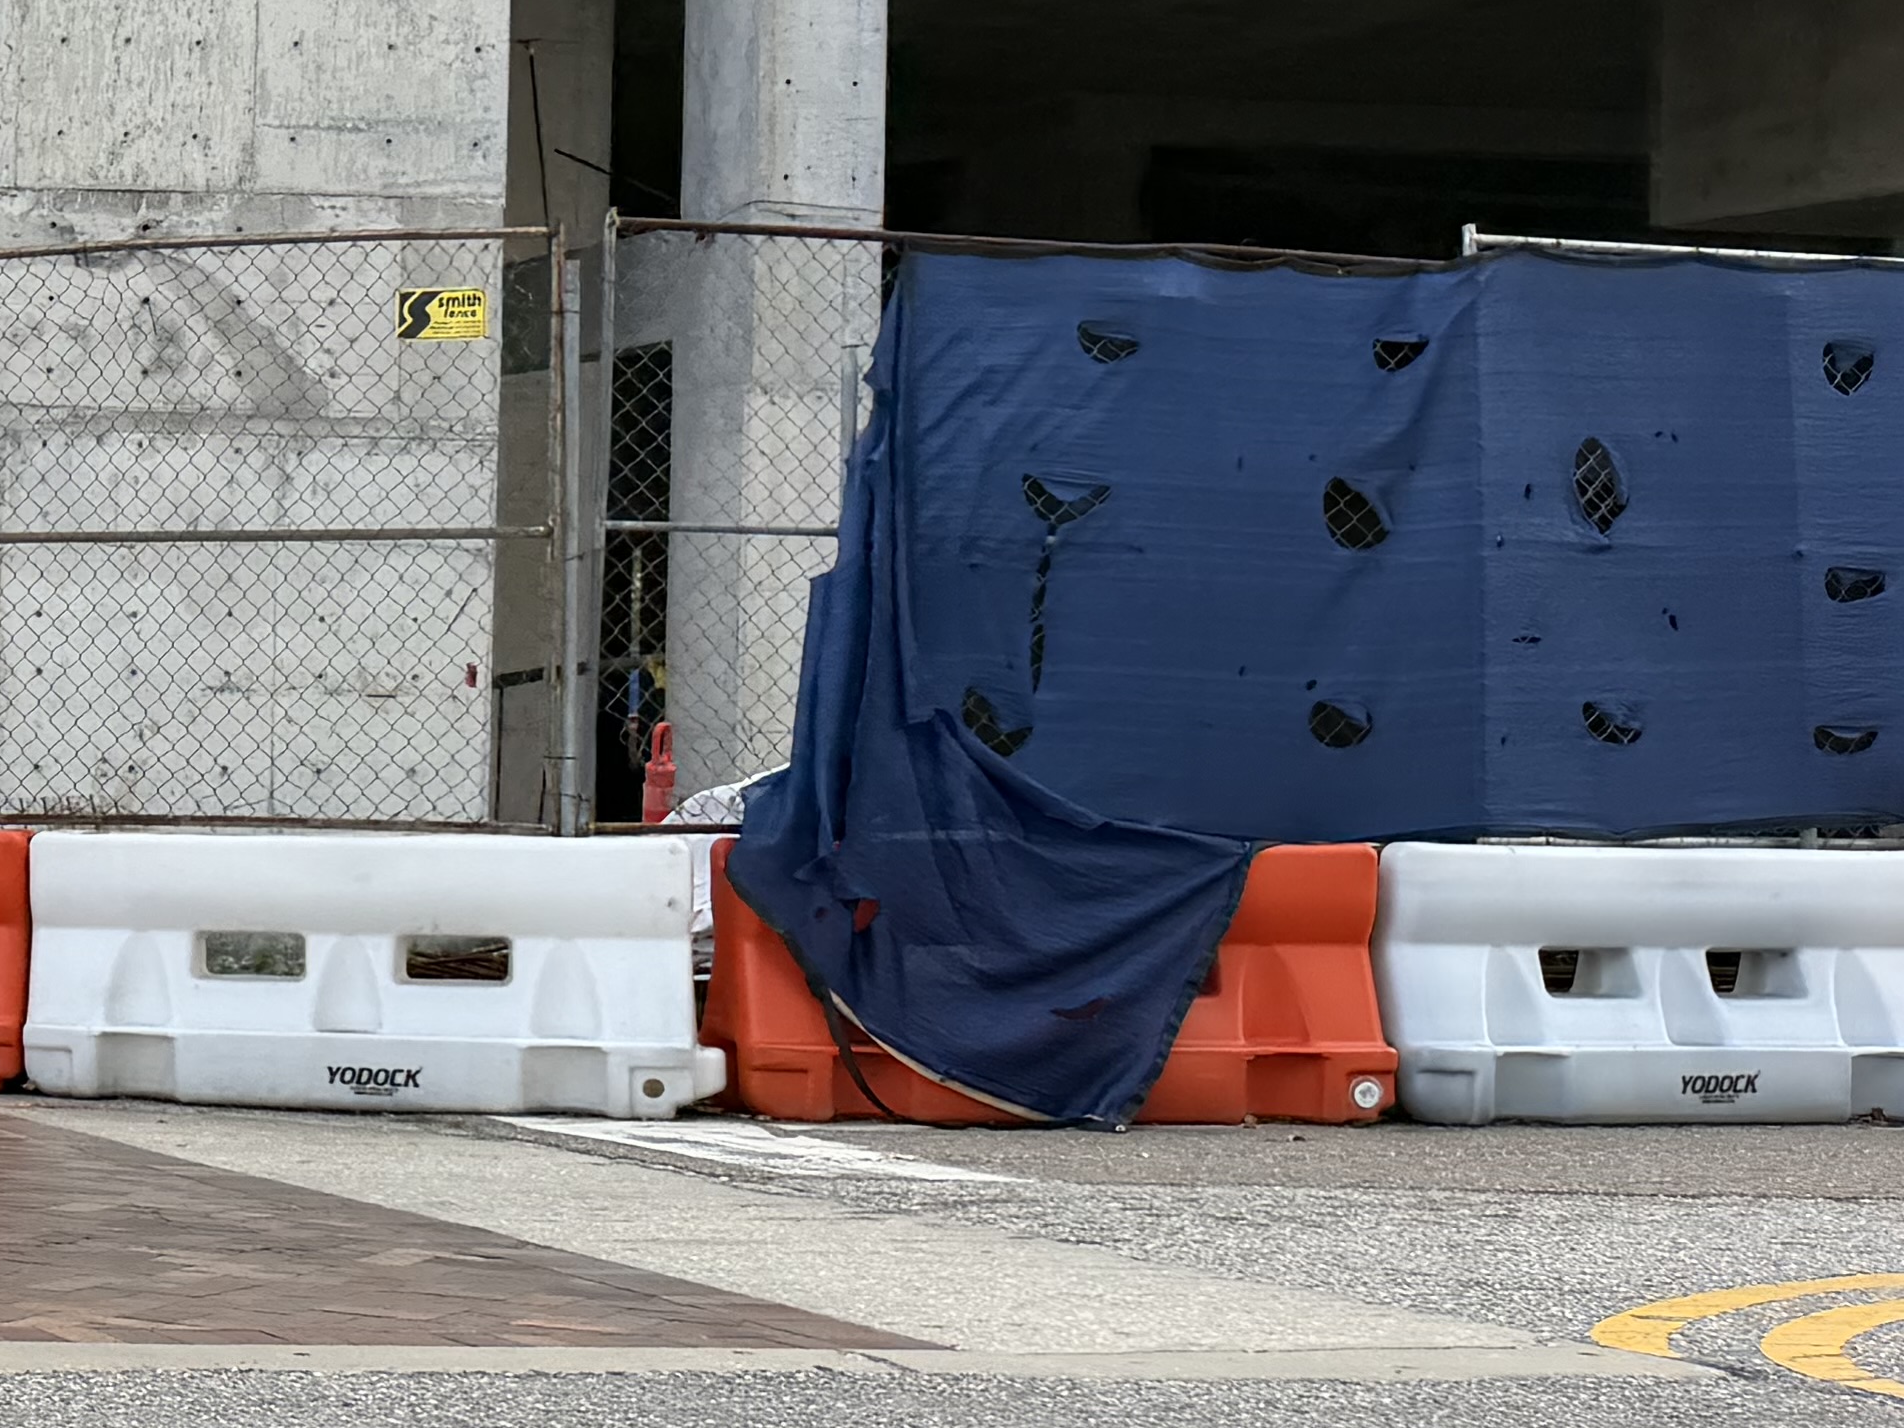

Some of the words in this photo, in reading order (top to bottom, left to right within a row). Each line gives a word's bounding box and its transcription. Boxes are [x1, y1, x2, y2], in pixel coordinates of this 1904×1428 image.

[437, 293, 482, 309] smith
[326, 1065, 423, 1089] YODOCK
[1680, 1069, 1761, 1095] YODOCK
